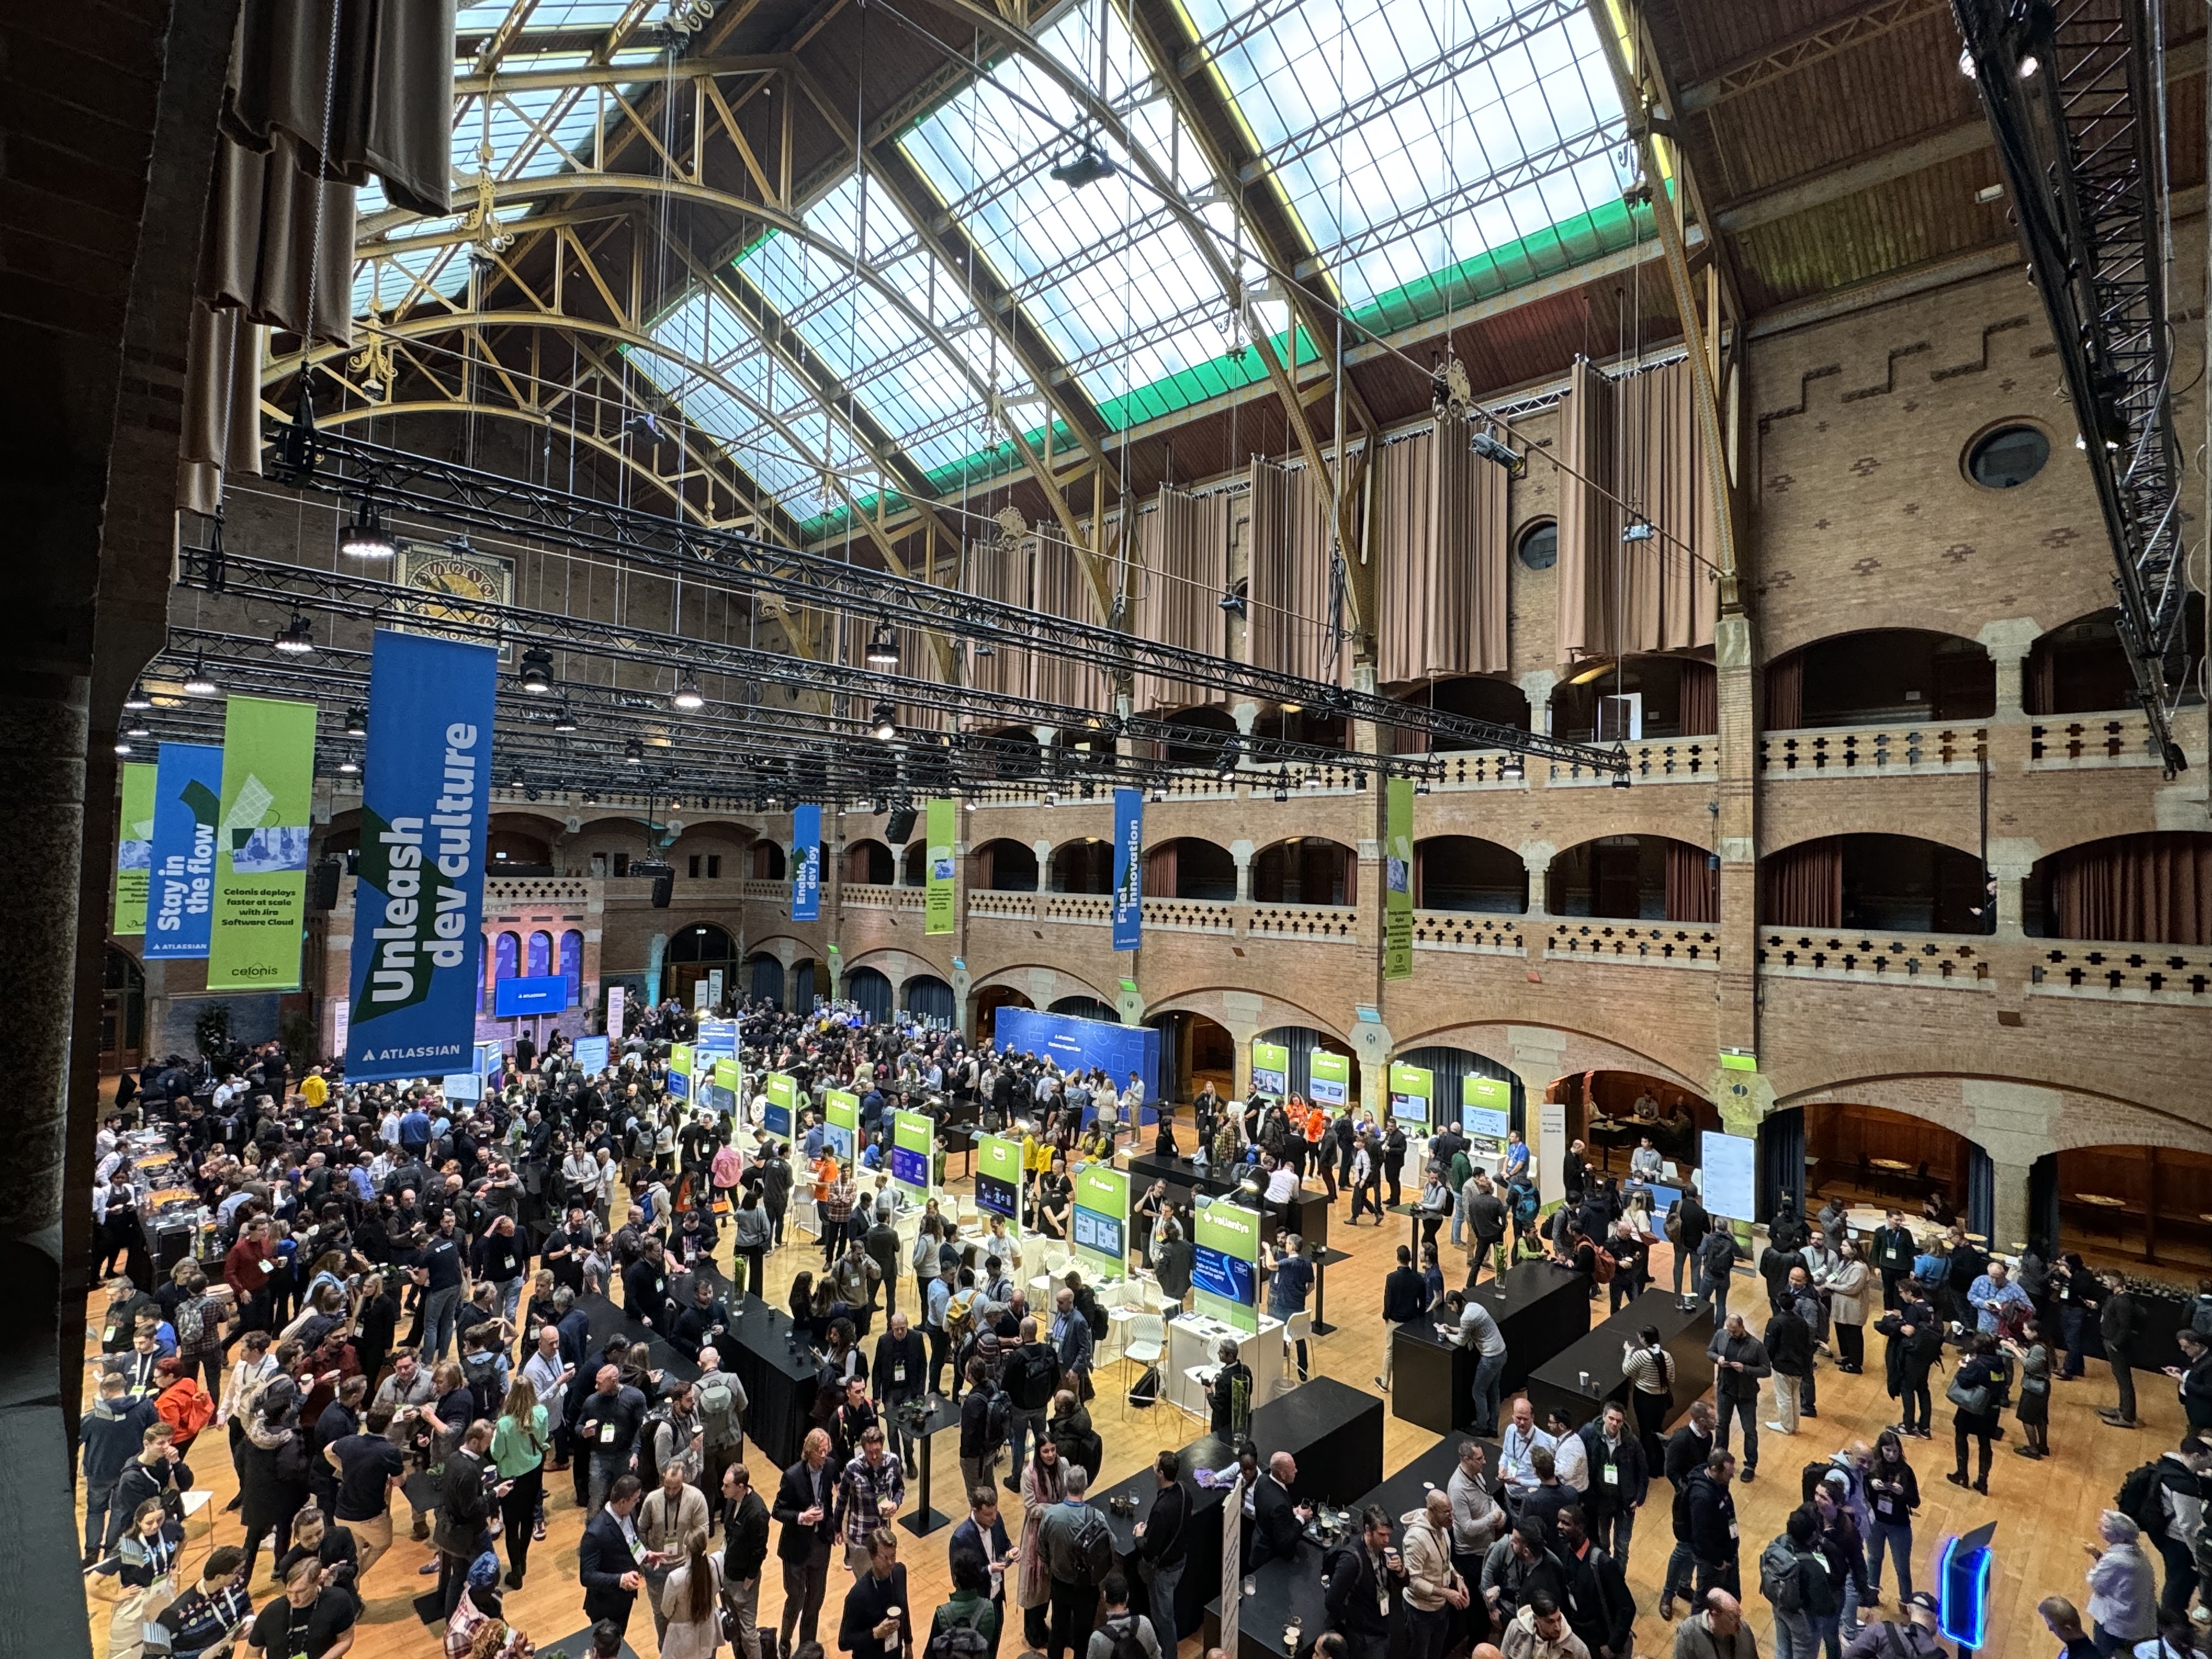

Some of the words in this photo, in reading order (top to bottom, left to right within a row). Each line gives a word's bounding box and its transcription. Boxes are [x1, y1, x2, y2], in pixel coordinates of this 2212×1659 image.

[433, 564, 441, 574] 11
[452, 563, 461, 573] 12
[473, 572, 477, 581] 1
[484, 585, 492, 596] 2
[431, 723, 477, 877] culture
[187, 823, 214, 874] flow
[806, 846, 819, 865] joy
[158, 856, 185, 876] in
[1127, 820, 1138, 907] innovation
[797, 862, 806, 904] Enable
[806, 867, 816, 889] dev
[185, 878, 210, 914] the
[260, 889, 296, 897] deploys
[157, 879, 189, 930] Stay
[372, 817, 424, 1002] Unleash
[1118, 887, 1127, 923] Fuel
[422, 885, 467, 967] dev
[232, 965, 278, 976] celonis
[380, 1045, 460, 1060] ATLASSIAN
